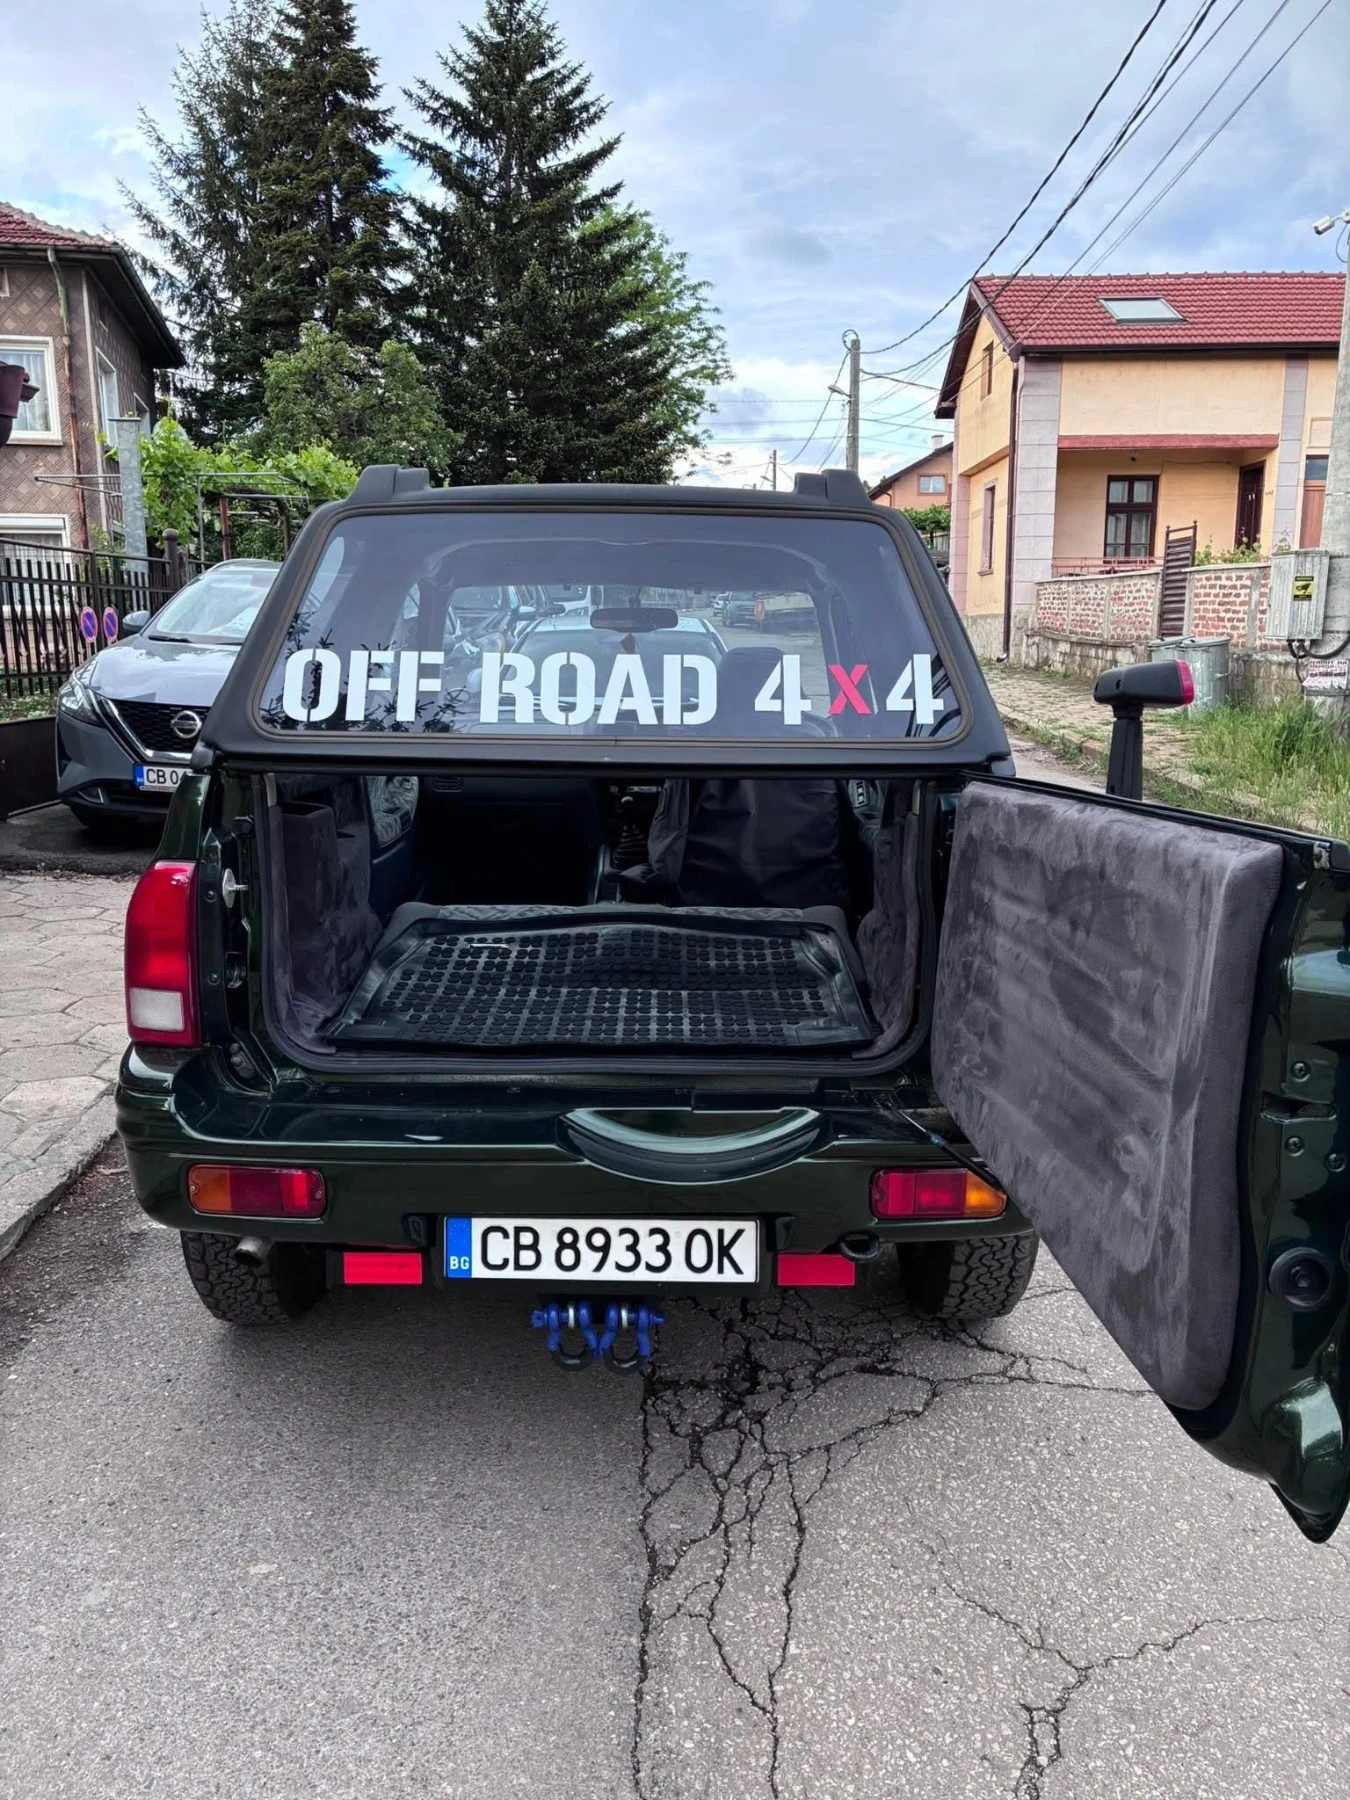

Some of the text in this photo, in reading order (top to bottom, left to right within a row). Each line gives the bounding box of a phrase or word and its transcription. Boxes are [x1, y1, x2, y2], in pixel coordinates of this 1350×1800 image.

[282, 648, 445, 722] OFF
[479, 651, 718, 725] ROAD
[146, 768, 167, 784] CB
[449, 1256, 470, 1270] BG
[481, 1225, 746, 1275] CB 8933 OK
